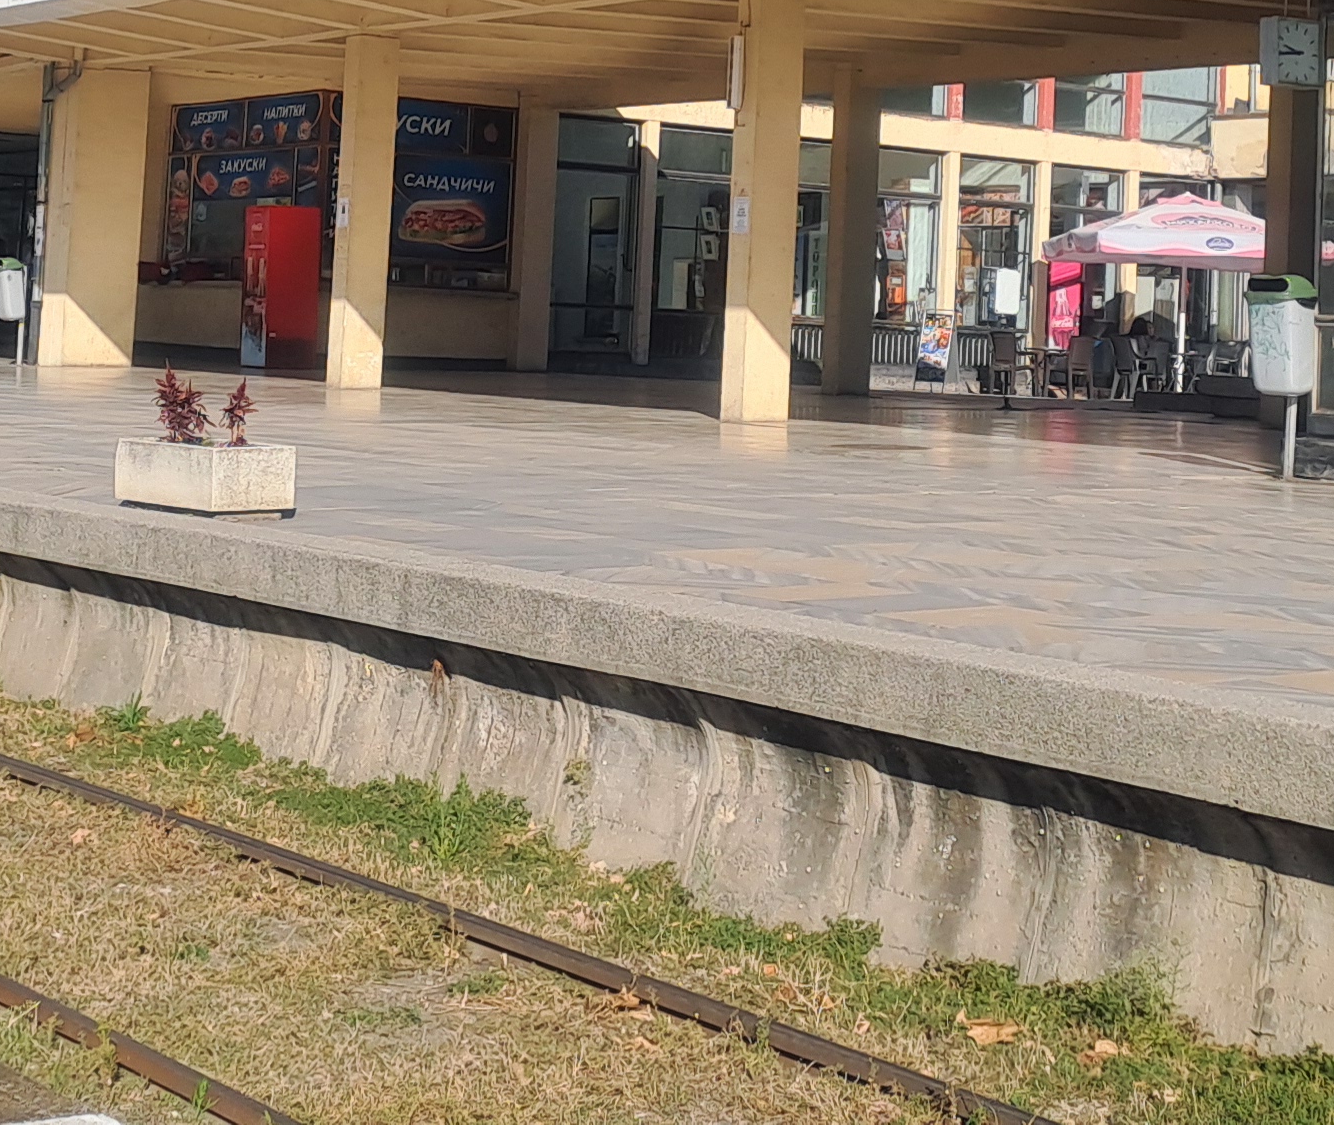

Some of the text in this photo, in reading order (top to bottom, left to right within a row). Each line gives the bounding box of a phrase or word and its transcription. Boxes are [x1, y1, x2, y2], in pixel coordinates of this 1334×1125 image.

[190, 109, 228, 126] ДЕСЕРТИ
[263, 104, 306, 120] НАПИТКИ
[219, 157, 267, 173] ЗАКУСКИ
[403, 173, 495, 193] САНДЧИЧИ
